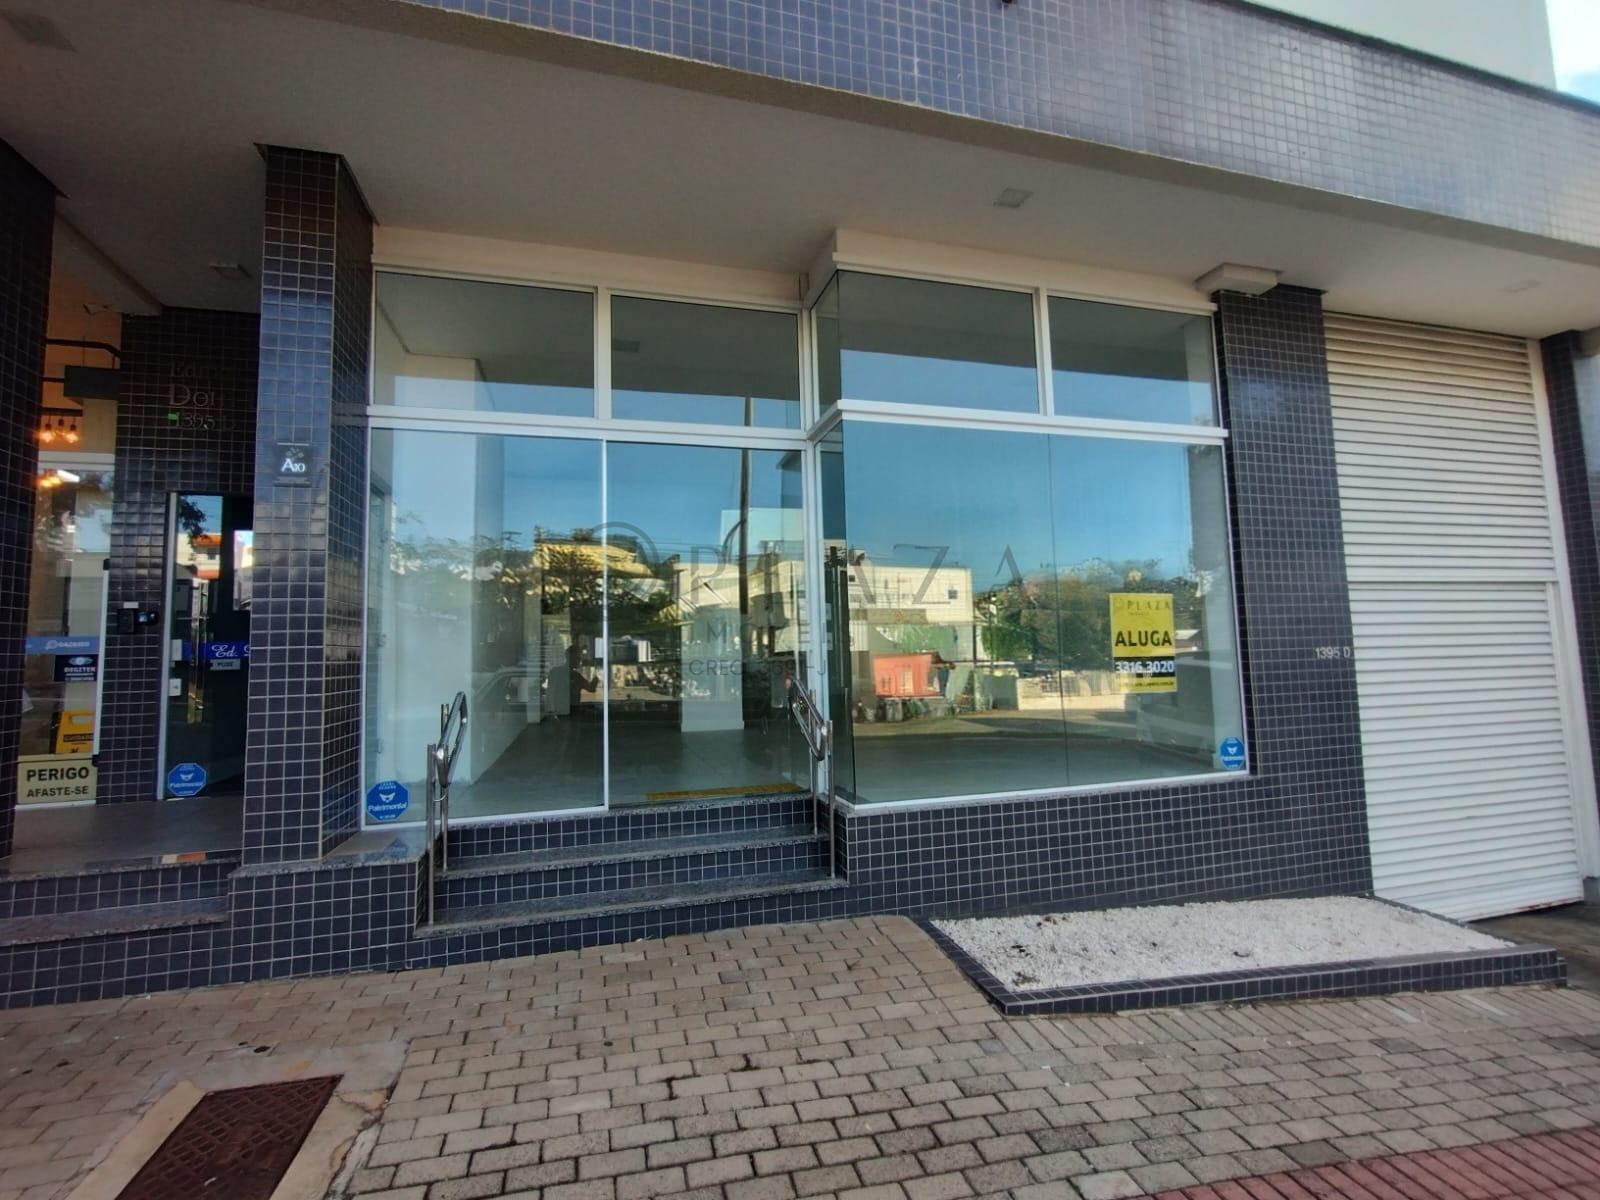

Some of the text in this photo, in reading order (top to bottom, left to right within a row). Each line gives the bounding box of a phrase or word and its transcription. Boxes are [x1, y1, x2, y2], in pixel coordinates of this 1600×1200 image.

[1114, 629, 1173, 647] ALUGA
[1314, 647, 1341, 660] 1395
[26, 766, 90, 782] PERIGO
[26, 785, 89, 798] AFASTE-SE
[368, 802, 407, 811] Patrimonial
